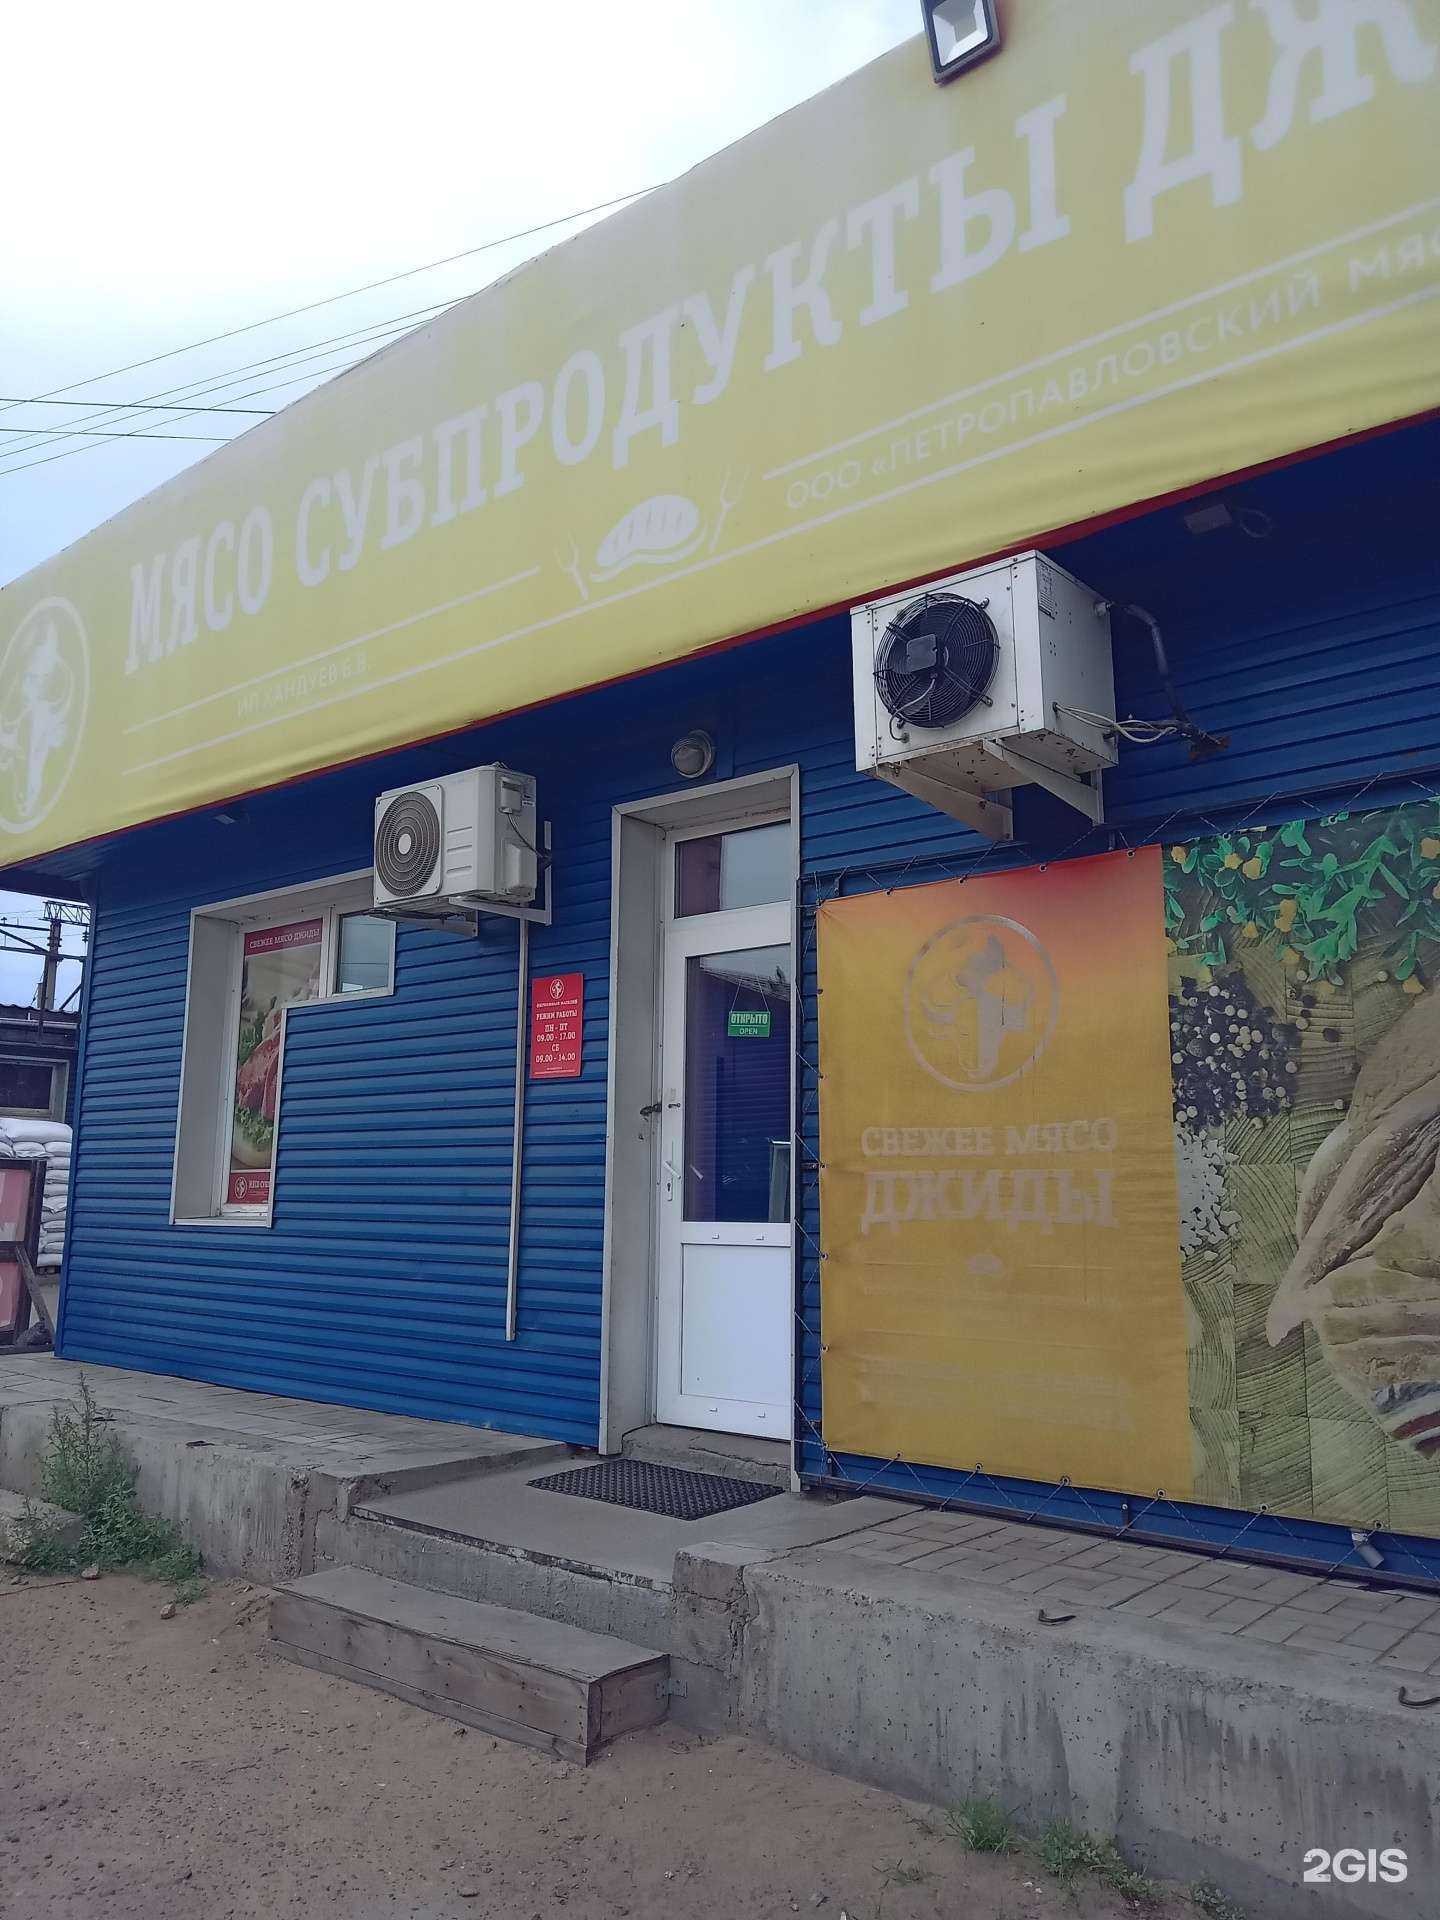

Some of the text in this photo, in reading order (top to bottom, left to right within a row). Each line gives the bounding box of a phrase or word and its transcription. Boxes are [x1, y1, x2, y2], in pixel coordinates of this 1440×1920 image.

[124, 506, 274, 675] МЯСО
[295, 94, 1070, 588] СУБПРОДУКТЫ
[785, 460, 862, 510] ООО
[870, 271, 1322, 477] «ПЕТРОПАВЛОВСКИЙ
[536, 1009, 577, 1020] РЕЖИМ РАБОТЫ
[730, 1013, 768, 1024] ОТКРЫТО
[545, 1024, 554, 1032] ПН
[560, 1023, 568, 1031] ПТ
[739, 1027, 758, 1035] OPEN
[537, 1034, 554, 1042] 09.00
[560, 1032, 576, 1041] 17.00
[535, 1054, 553, 1063] 09.00
[861, 1118, 1118, 1157] СВЕЖЕЕ МЯСО
[860, 1168, 1119, 1235] ДЖИДЫ
